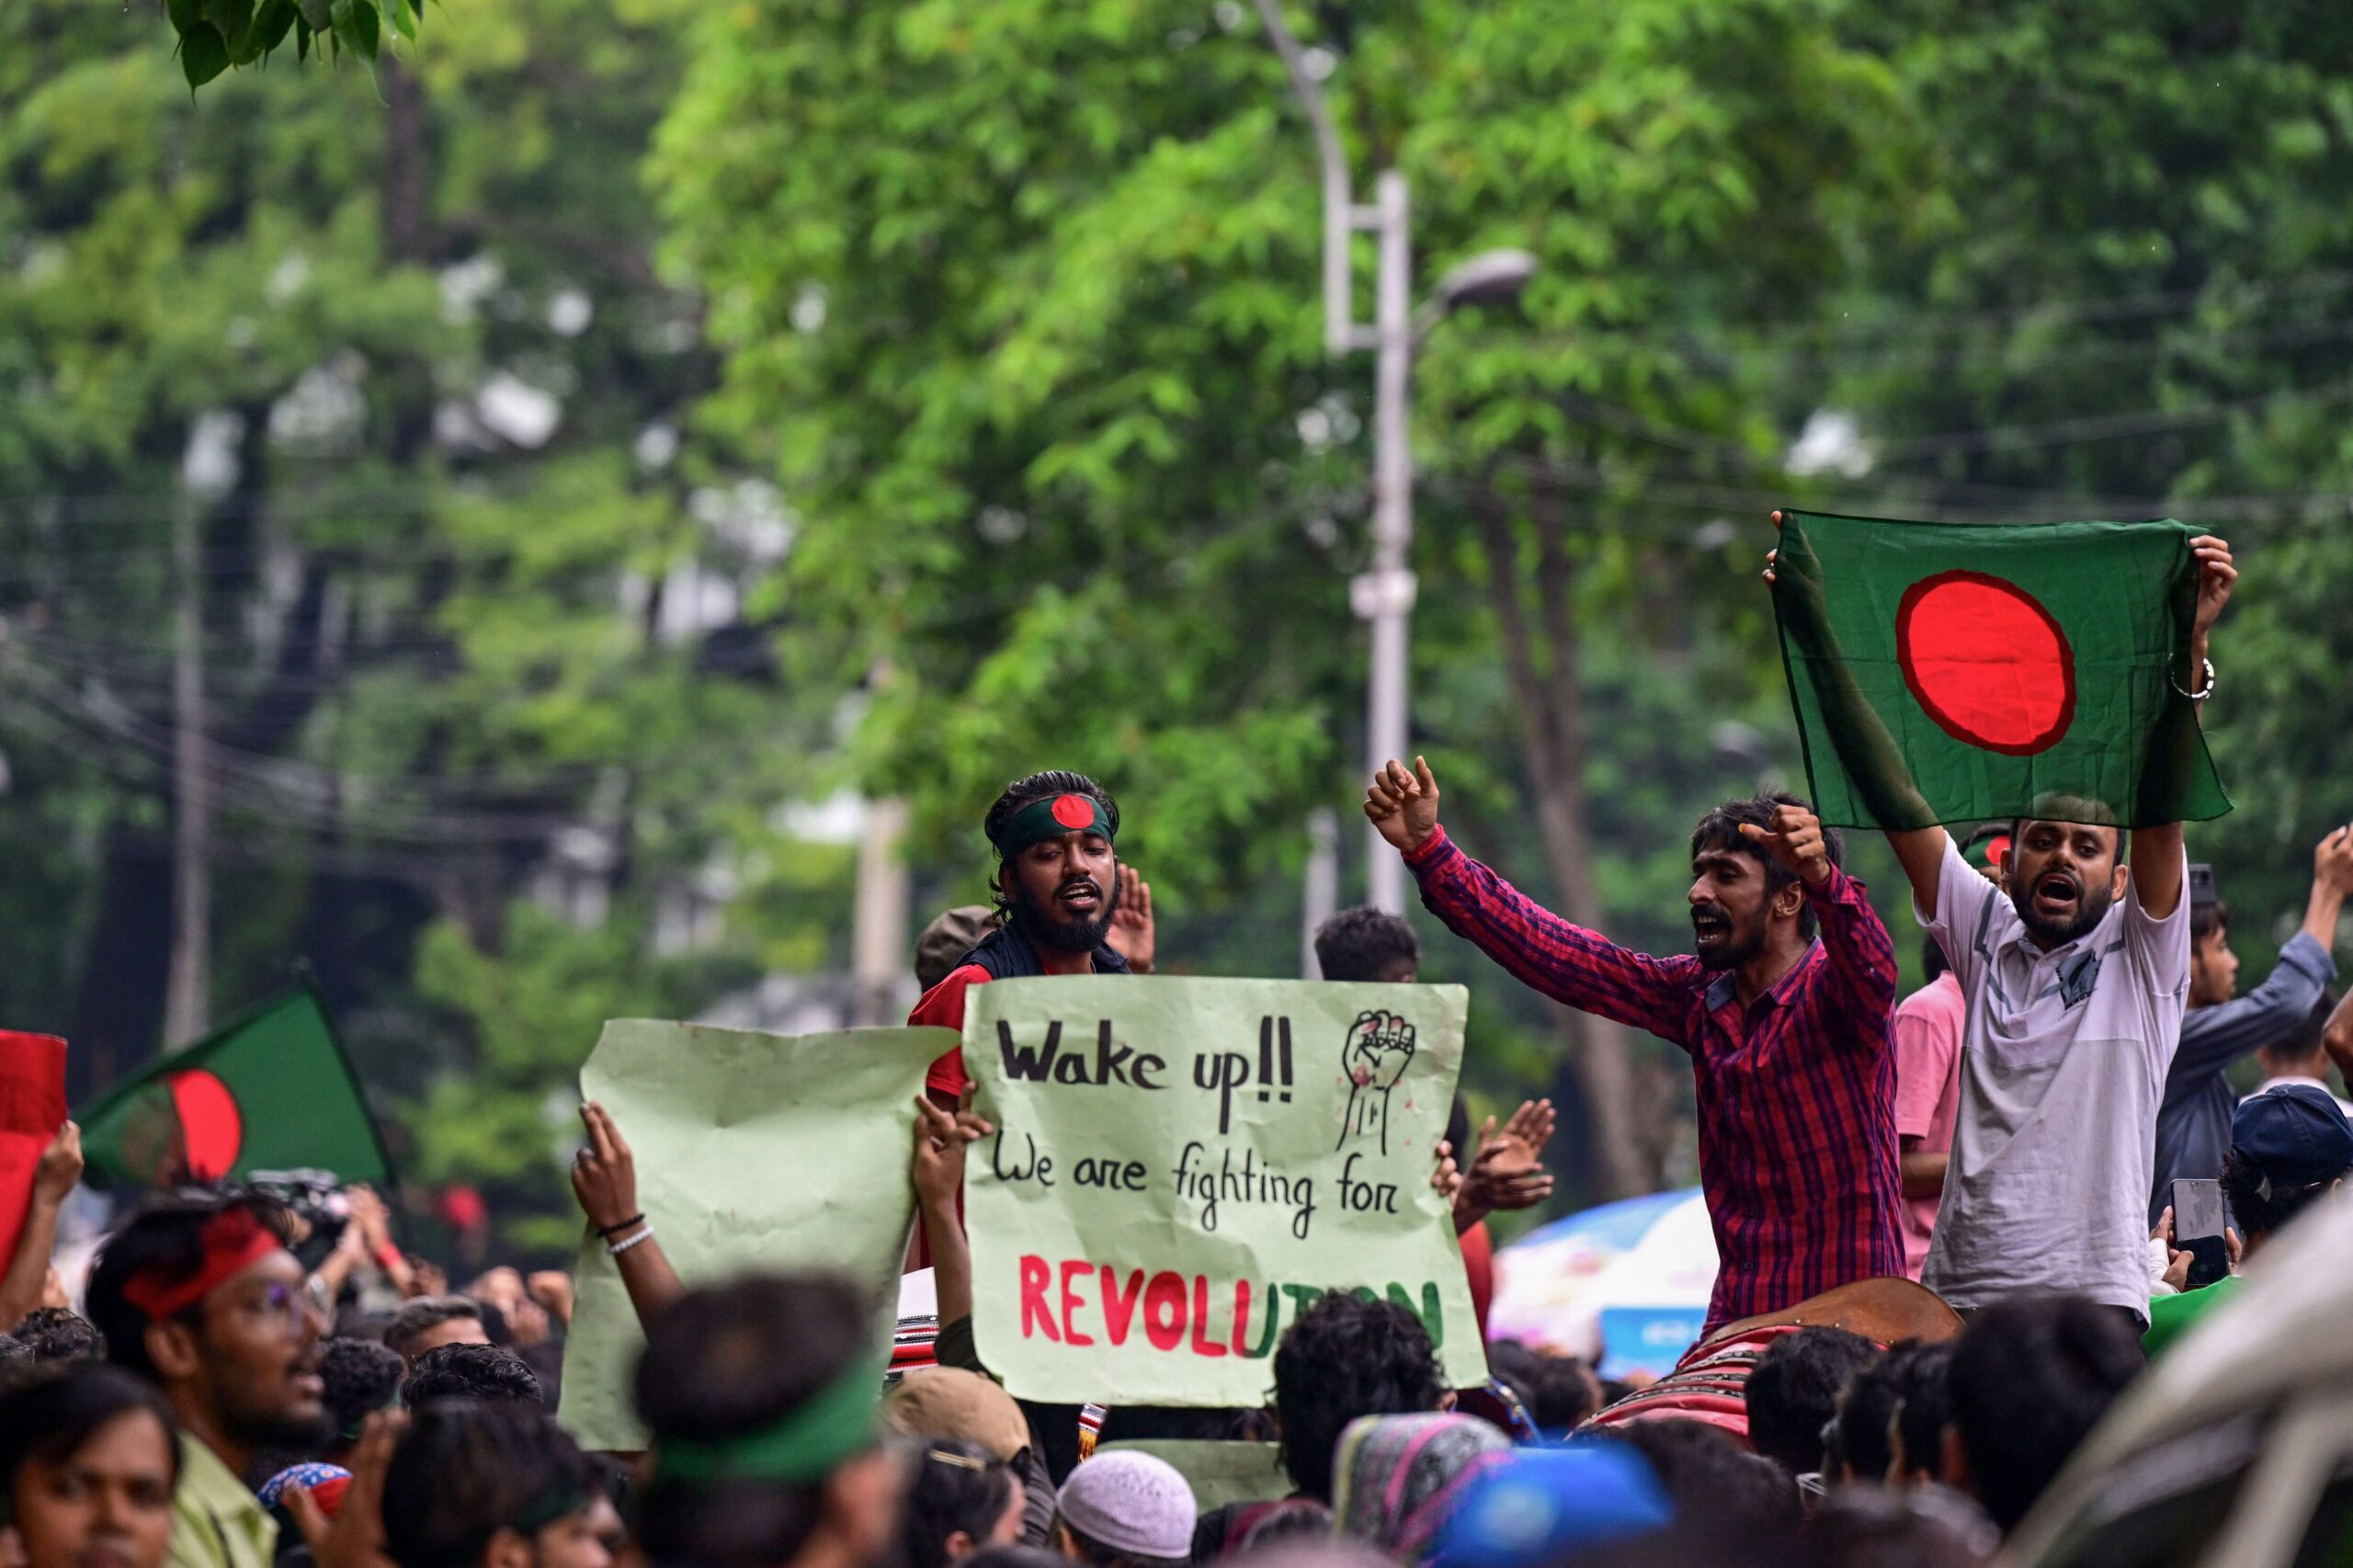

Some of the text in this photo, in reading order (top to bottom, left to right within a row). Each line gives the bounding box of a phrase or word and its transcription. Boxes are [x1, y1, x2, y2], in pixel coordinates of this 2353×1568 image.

[996, 1016, 1294, 1134] Wake up!!
[993, 1130, 1398, 1240] We are fighting for
